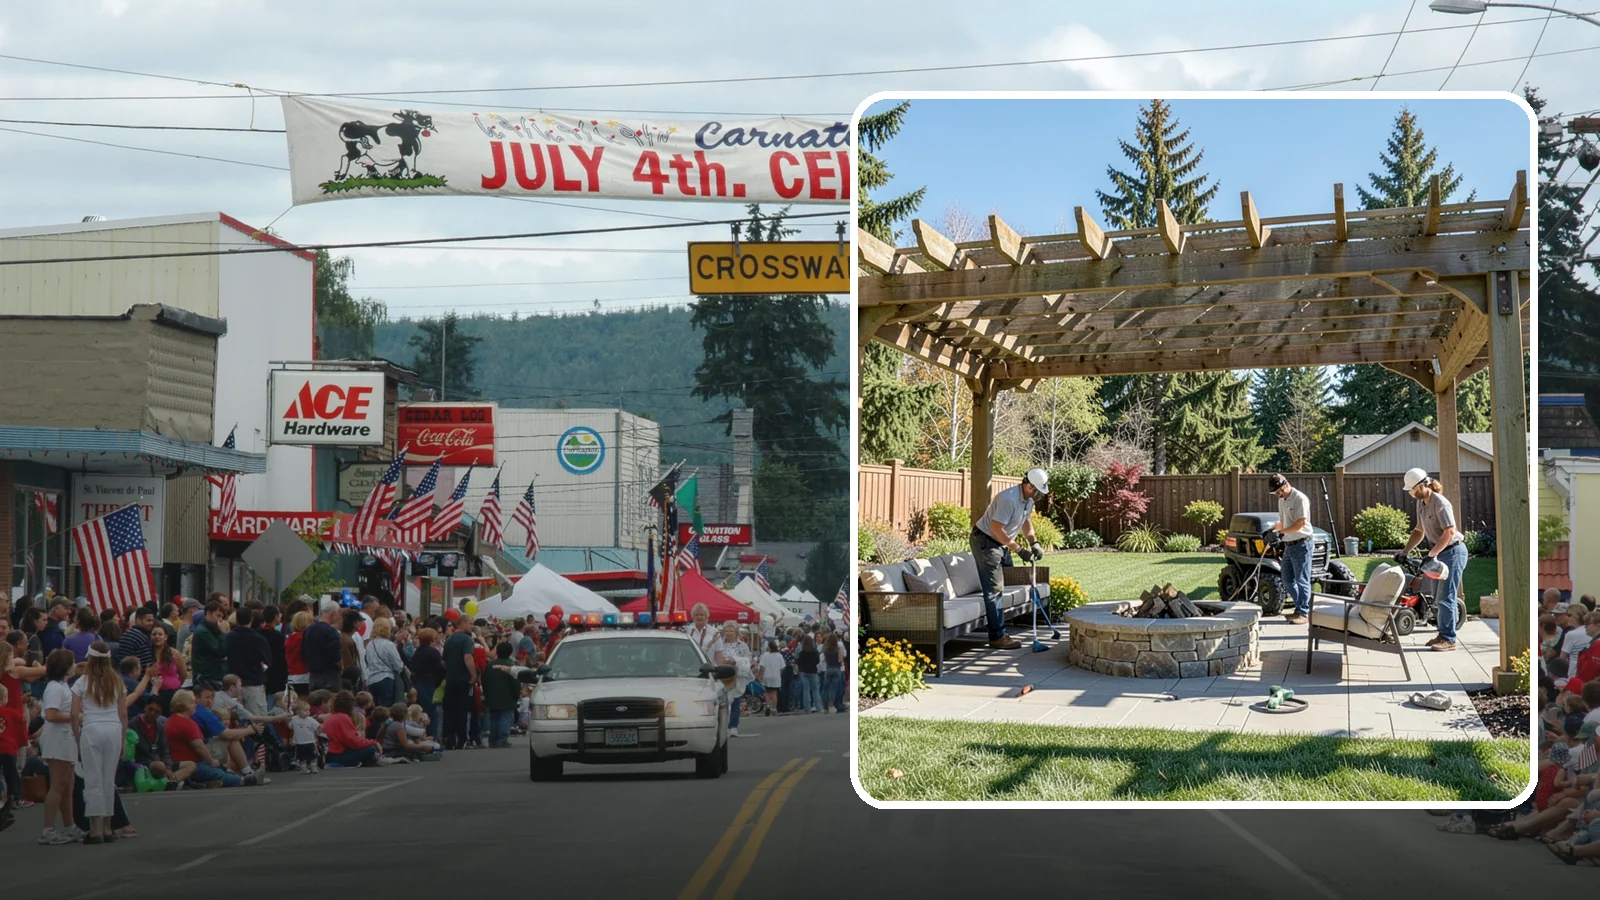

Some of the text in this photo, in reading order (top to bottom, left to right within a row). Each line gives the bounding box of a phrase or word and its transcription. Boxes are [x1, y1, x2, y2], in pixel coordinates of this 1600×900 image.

[695, 121, 850, 149] Carnat
[481, 141, 605, 192] JULY
[632, 150, 747, 197] 4th.
[697, 254, 850, 280] CROSSWA
[283, 380, 373, 420] ACE
[406, 409, 452, 422] CEDAR
[283, 421, 371, 436] Hardware
[96, 485, 124, 495] Vincent
[126, 486, 136, 495] de
[138, 486, 155, 495] Paul
[688, 526, 741, 535] CRNATION
[699, 535, 730, 543] GLASS
